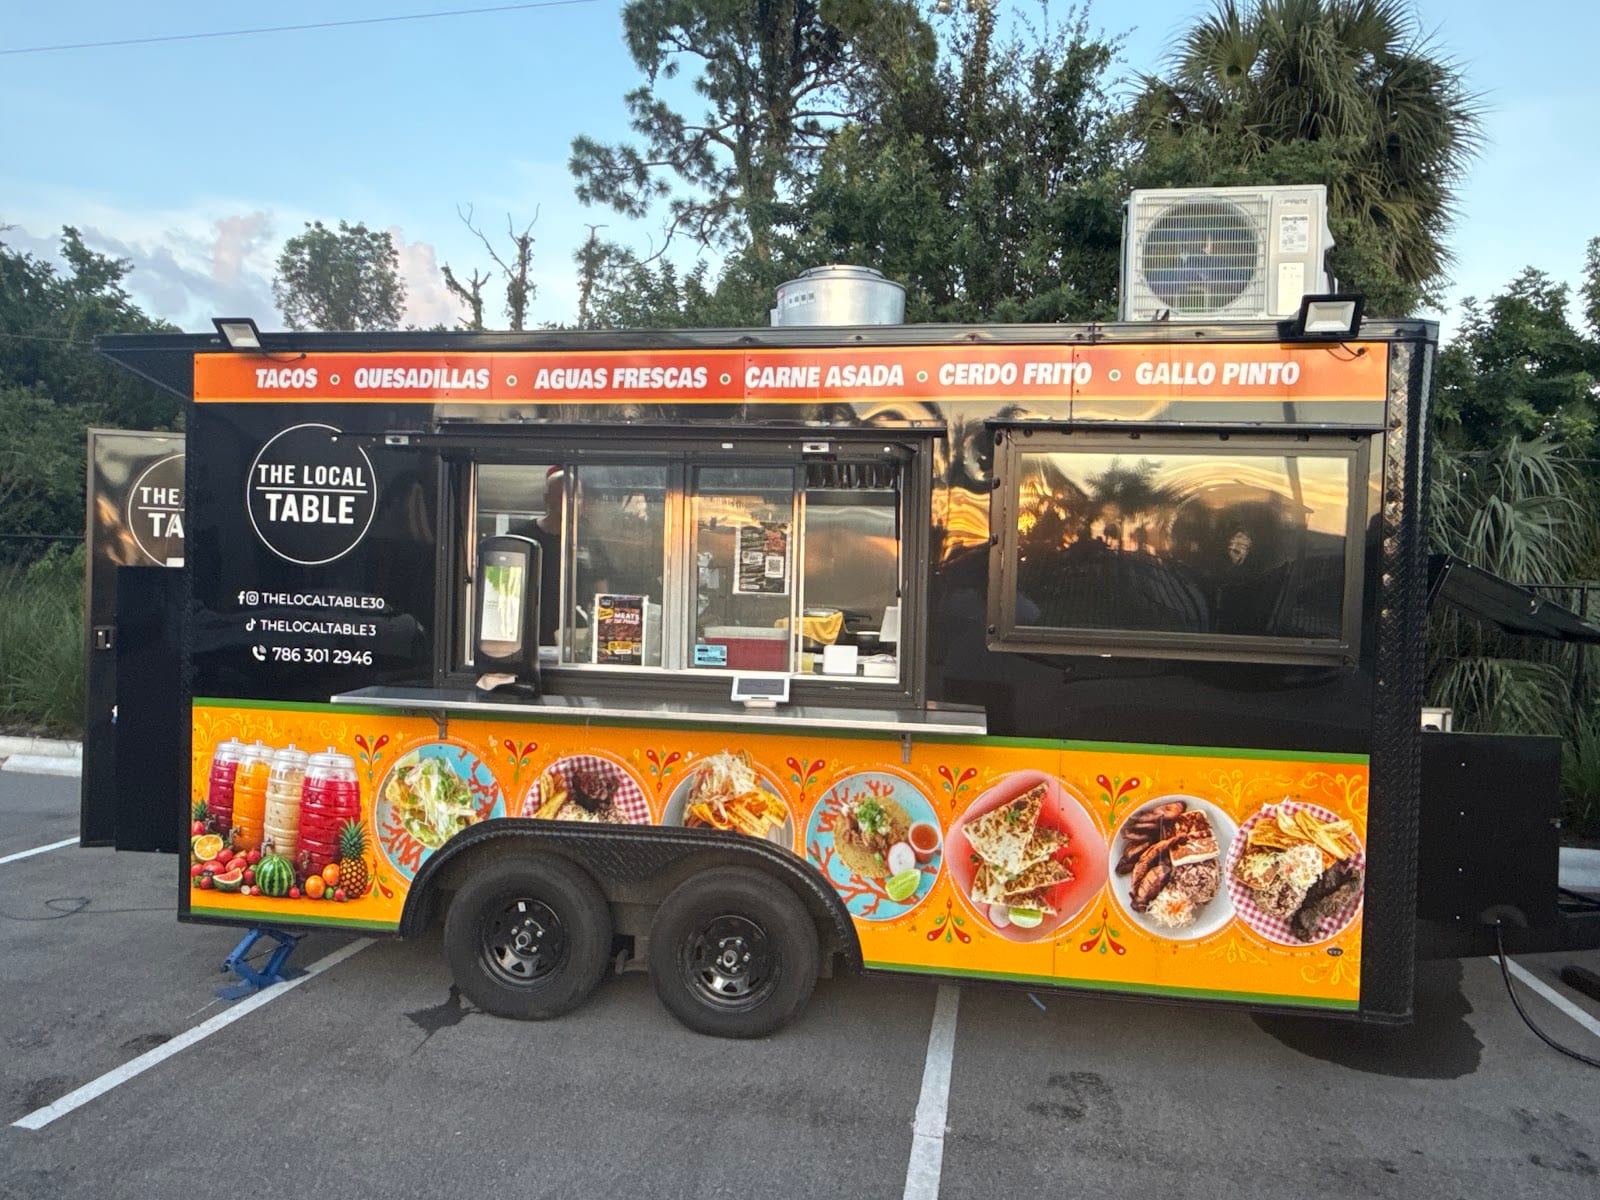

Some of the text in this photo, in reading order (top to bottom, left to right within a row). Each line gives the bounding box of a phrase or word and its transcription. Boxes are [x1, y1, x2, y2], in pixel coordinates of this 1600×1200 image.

[255, 361, 1300, 390] TACOS QUESADILLAS AGUAS FRESCAS CARNE ASADA CERDO FRITO GALLO PINTO
[257, 463, 367, 487] THE LOCAL
[139, 486, 180, 505] THE
[264, 493, 356, 525] TABLE
[261, 591, 385, 610] THELOCALTABLE30
[271, 646, 373, 666] 786 301 2946
